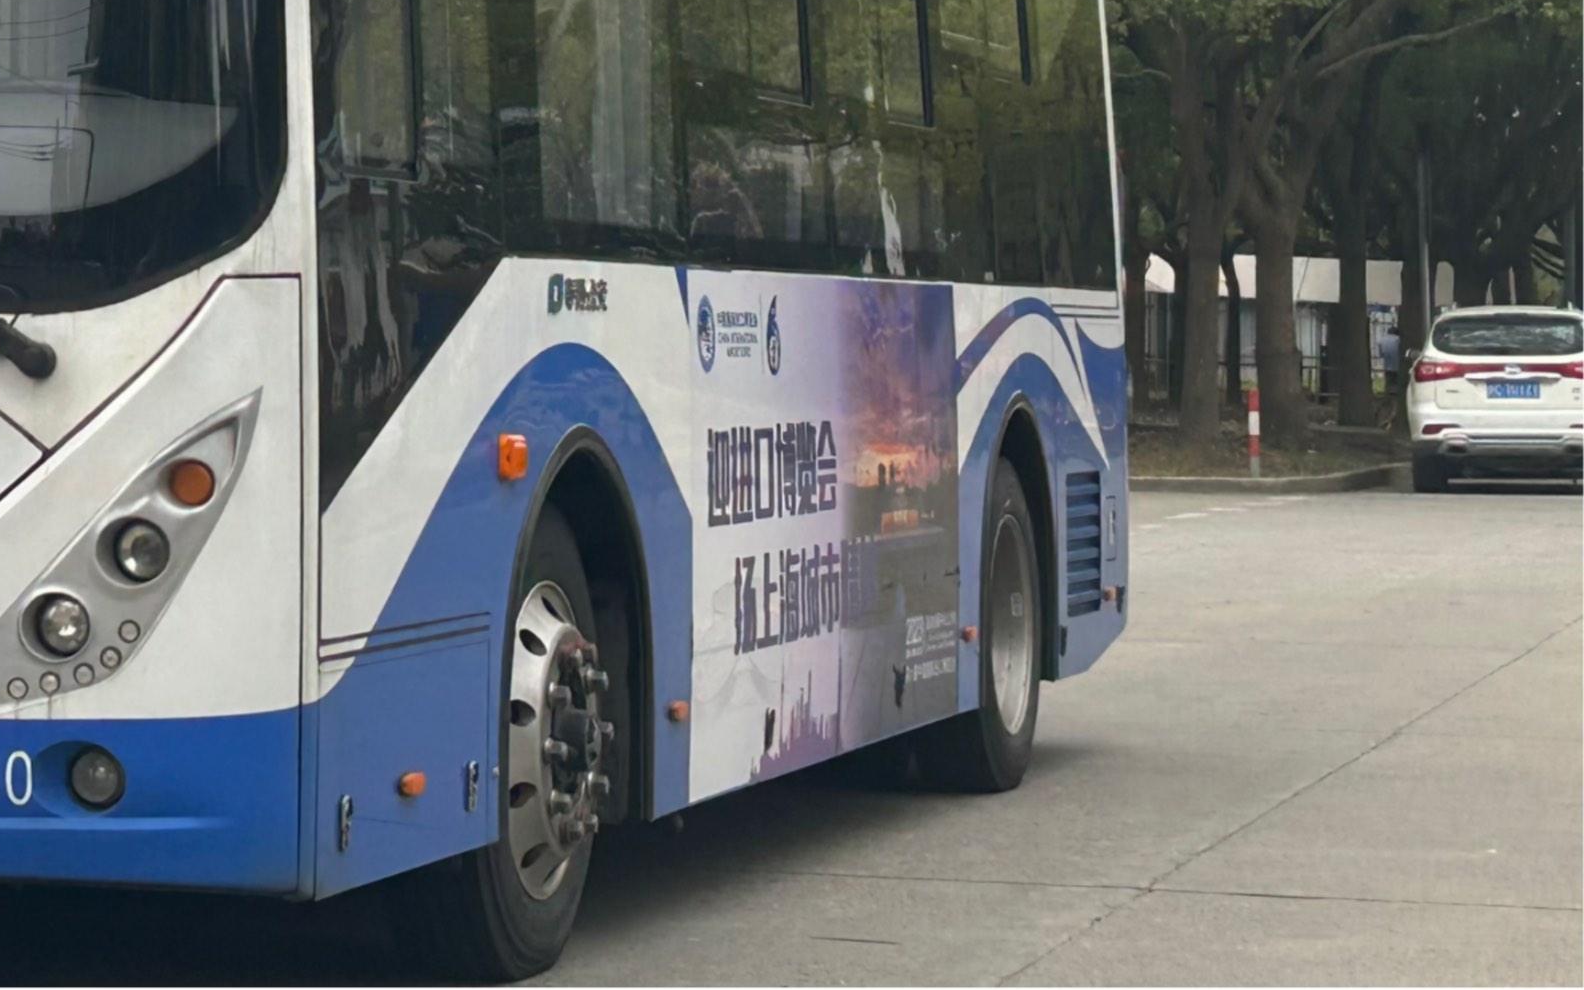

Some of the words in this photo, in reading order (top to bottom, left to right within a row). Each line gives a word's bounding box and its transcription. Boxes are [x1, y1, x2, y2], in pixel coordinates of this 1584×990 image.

[707, 420, 837, 528] 迎进口博览会
